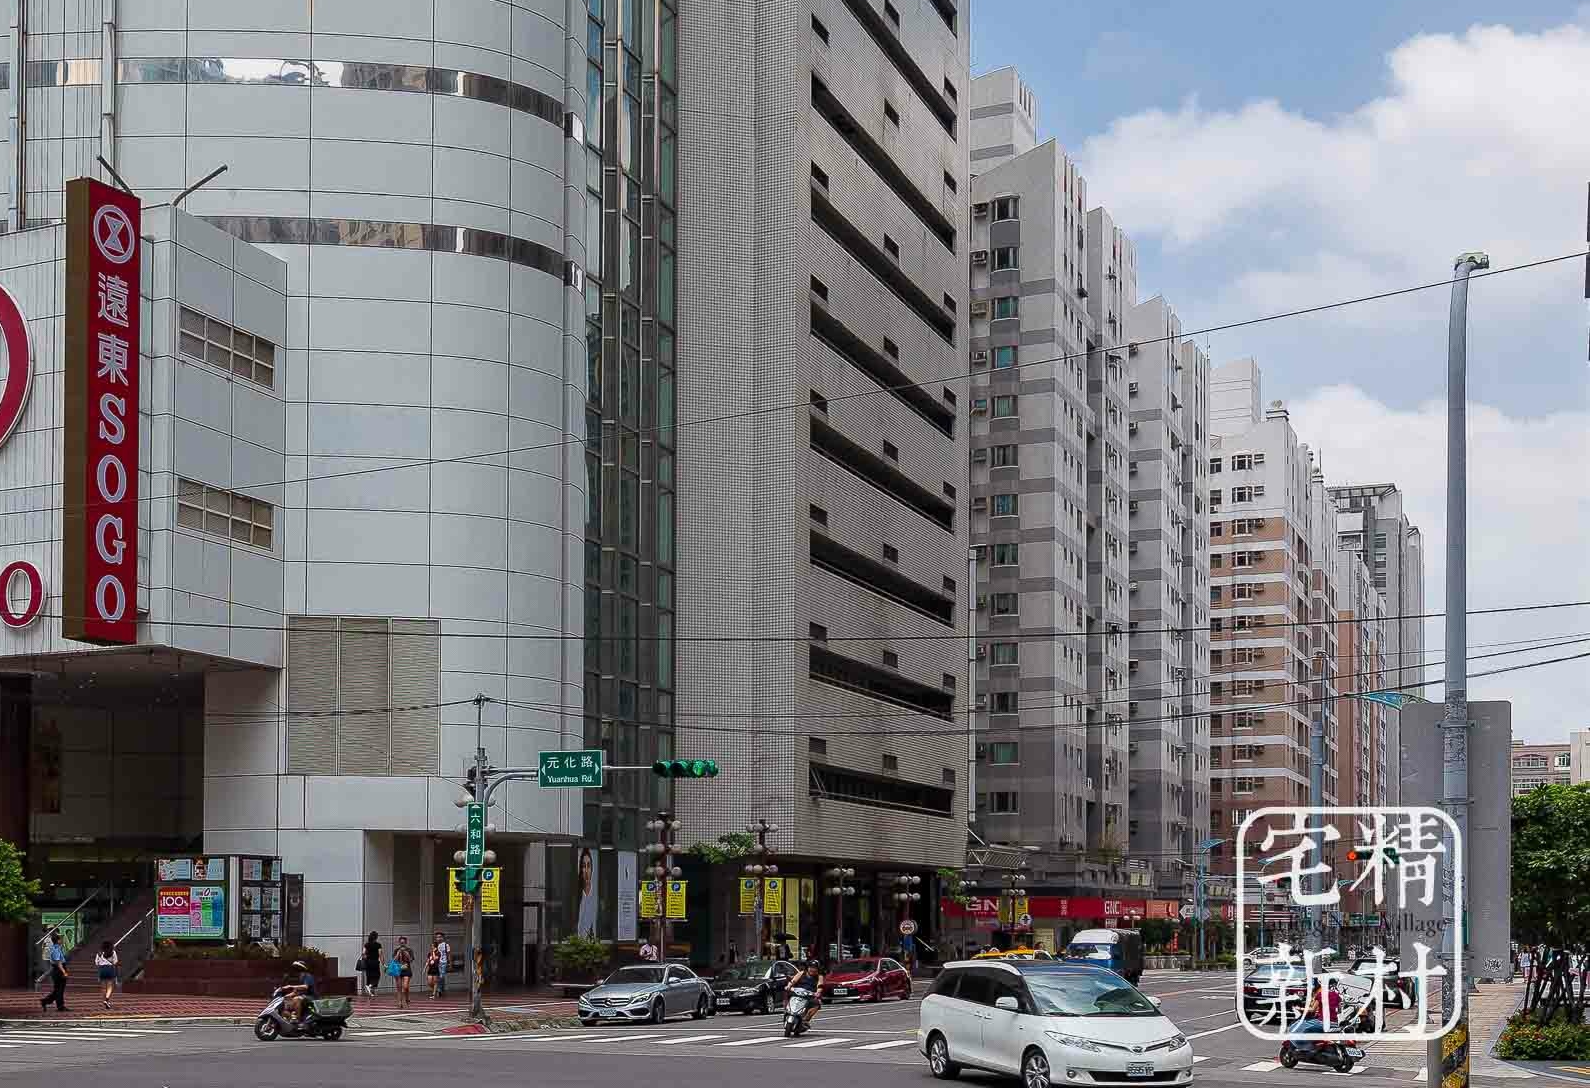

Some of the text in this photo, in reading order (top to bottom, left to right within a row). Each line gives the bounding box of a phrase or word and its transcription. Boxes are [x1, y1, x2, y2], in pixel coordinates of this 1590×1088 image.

[546, 756, 594, 770] 元化路
[547, 775, 594, 784] Yuanhua Rd.
[470, 812, 482, 856] 六和路
[966, 900, 999, 911] GN
[1104, 901, 1120, 914] GNC
